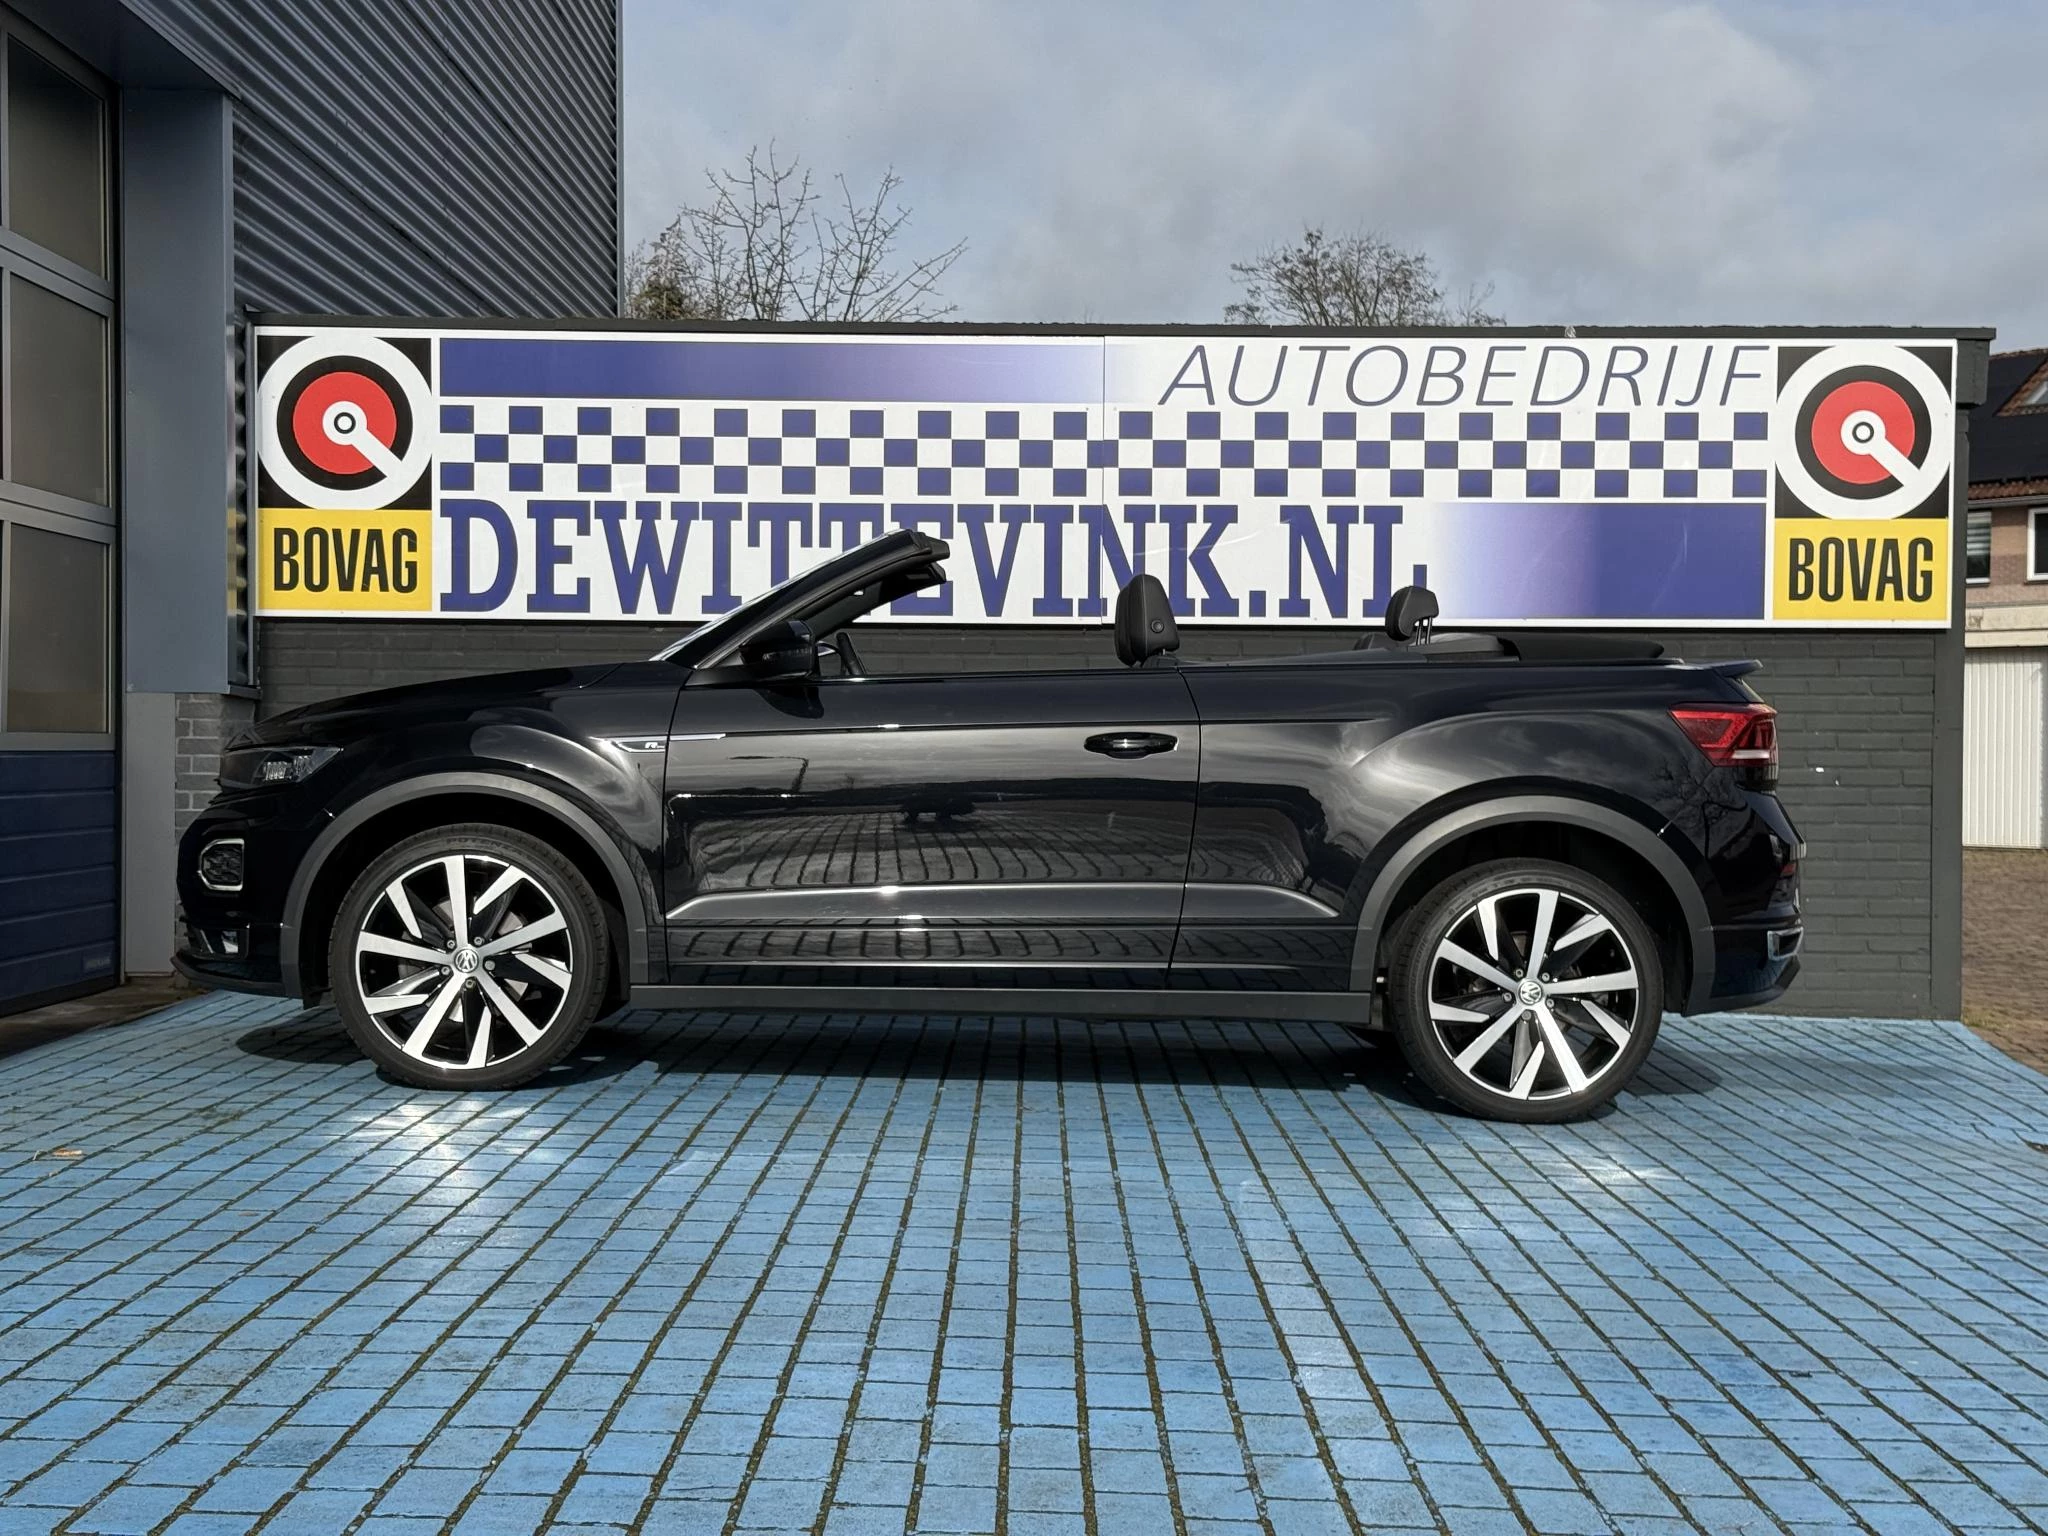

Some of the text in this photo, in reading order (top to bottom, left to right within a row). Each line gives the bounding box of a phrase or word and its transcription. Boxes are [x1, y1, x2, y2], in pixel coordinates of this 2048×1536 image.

[1158, 344, 1771, 407] AUTOBEDRIJF
[273, 526, 418, 594] BOVAG
[1788, 537, 1934, 603] BOVAG
